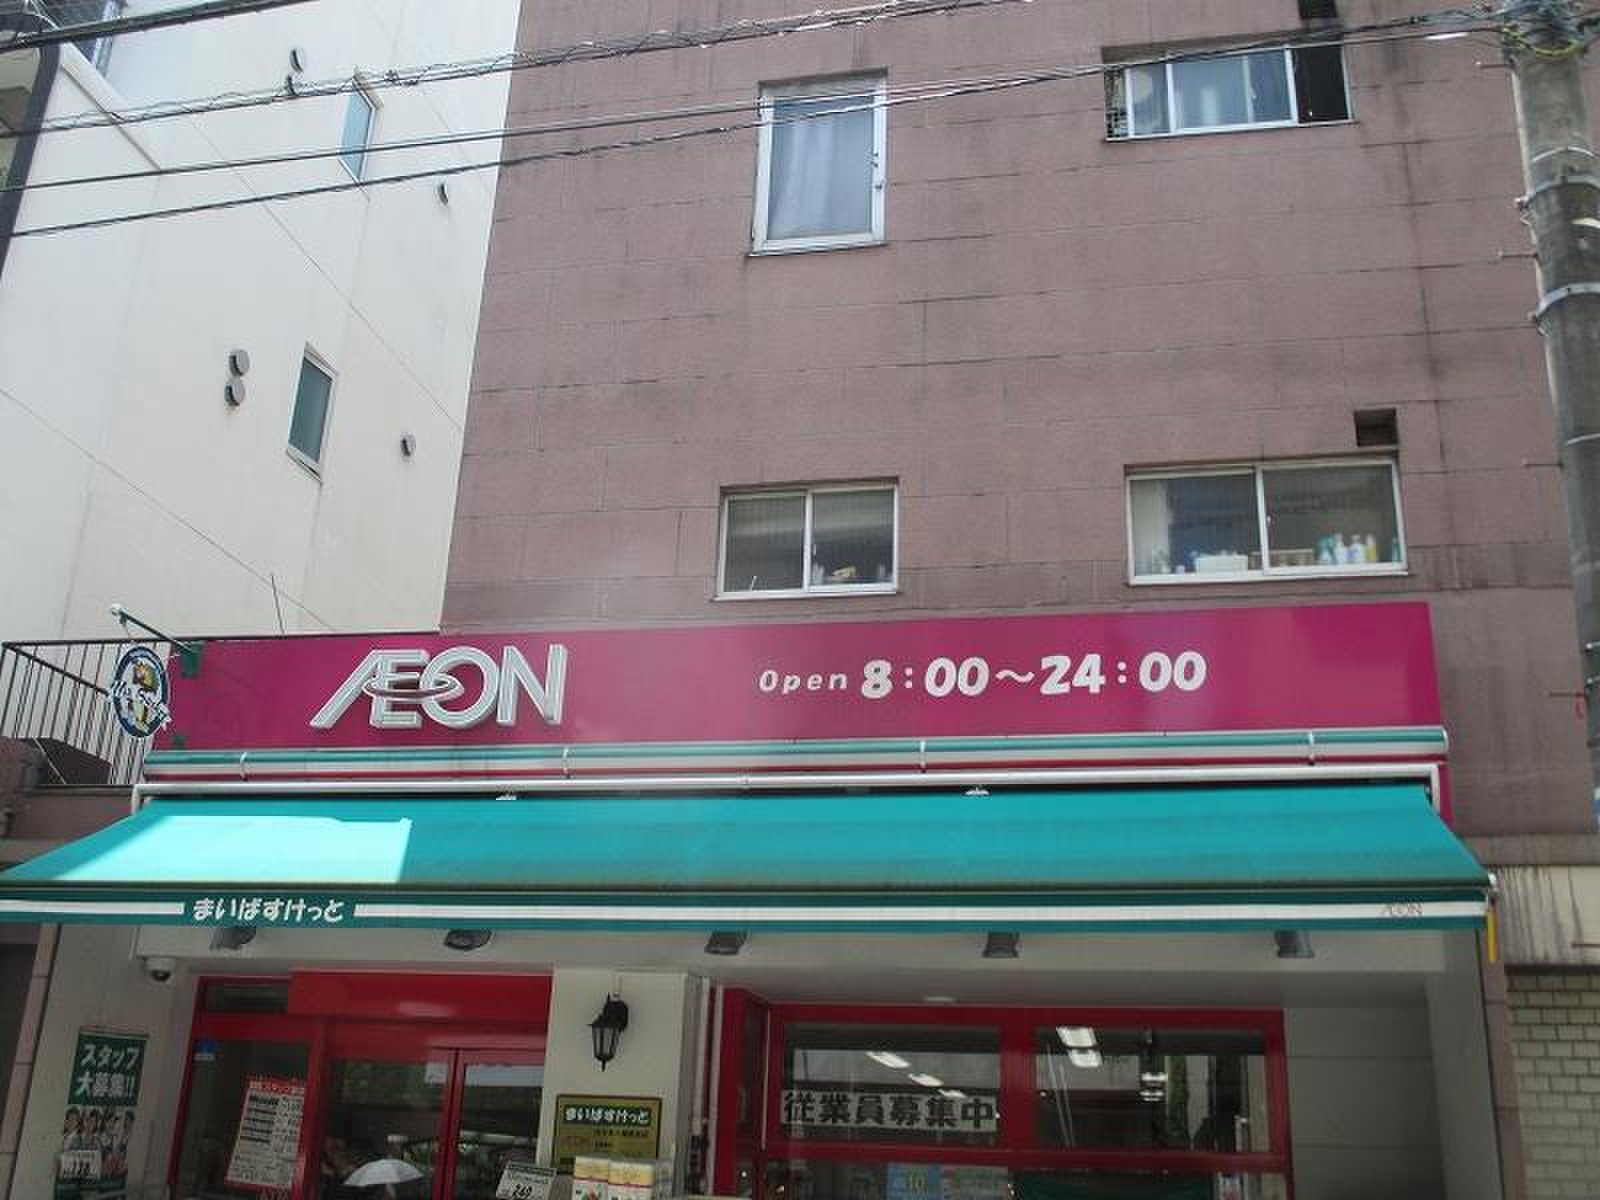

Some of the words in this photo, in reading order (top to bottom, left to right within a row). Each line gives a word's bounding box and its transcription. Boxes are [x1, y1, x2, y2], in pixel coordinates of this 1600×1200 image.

[759, 669, 848, 695] Open
[192, 897, 345, 923] まいばすけっと
[79, 1043, 140, 1070] スタッフ
[565, 1107, 649, 1124] まいばすけっと
[783, 1090, 994, 1129] 従業員募集中
